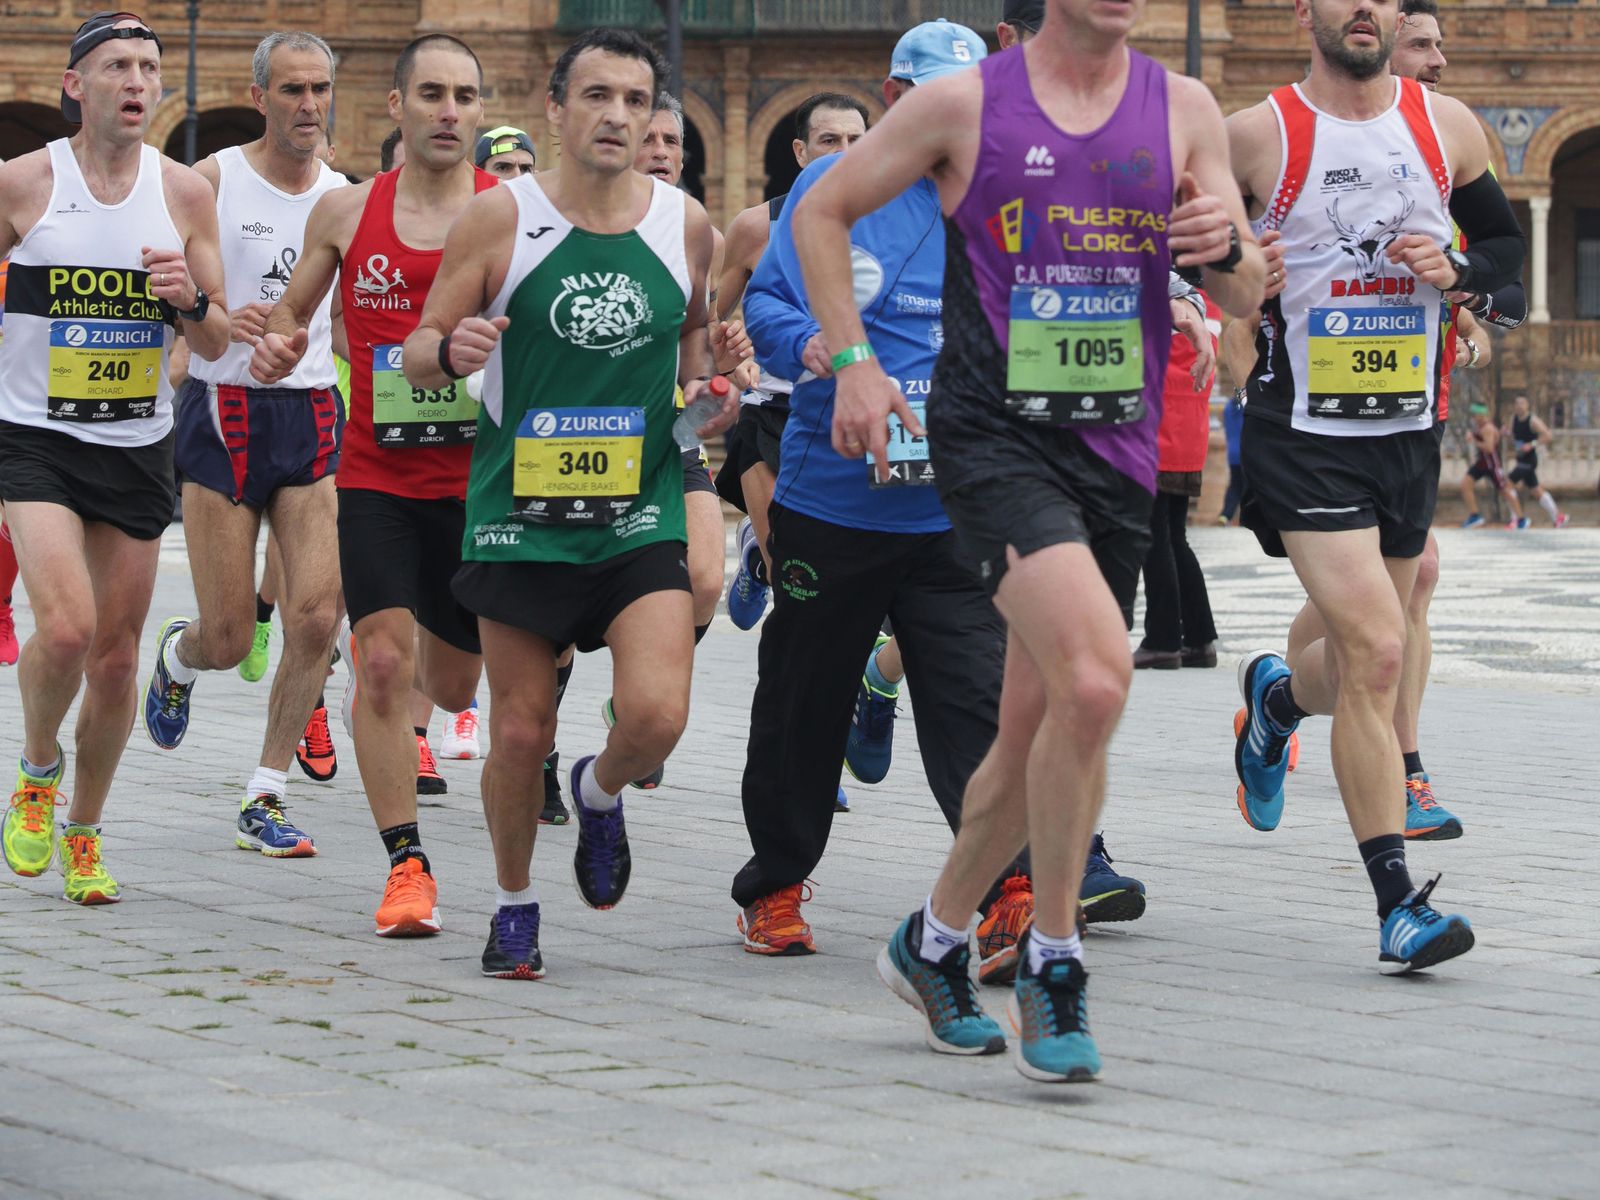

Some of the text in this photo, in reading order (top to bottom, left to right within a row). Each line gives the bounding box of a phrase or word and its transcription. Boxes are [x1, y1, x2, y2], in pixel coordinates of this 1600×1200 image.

[952, 40, 971, 62] 5
[1323, 175, 1362, 186] CACHET
[1047, 205, 1168, 232] PUERTAS
[1063, 233, 1158, 255] LORCA
[1015, 264, 1043, 285] C.A.
[1046, 264, 1104, 285] PUERTAS
[1330, 276, 1415, 298] BAMBIS
[49, 298, 164, 320] Athletic Club
[353, 293, 412, 310] Sevilla
[1066, 296, 1137, 314] ZURICH
[1352, 316, 1417, 331] ZURICH
[90, 330, 151, 344] ZURICH
[609, 334, 655, 358] VILA REAL
[1055, 338, 1125, 367] 1095
[1352, 349, 1398, 374] 394
[88, 360, 131, 381] 240
[87, 387, 124, 395] RICHARD
[411, 382, 457, 403] 533
[905, 380, 932, 395] ZU
[1358, 380, 1388, 389] DAVID
[417, 409, 448, 418] PEDRO
[559, 416, 631, 431] ZURICH
[558, 451, 609, 475] 340
